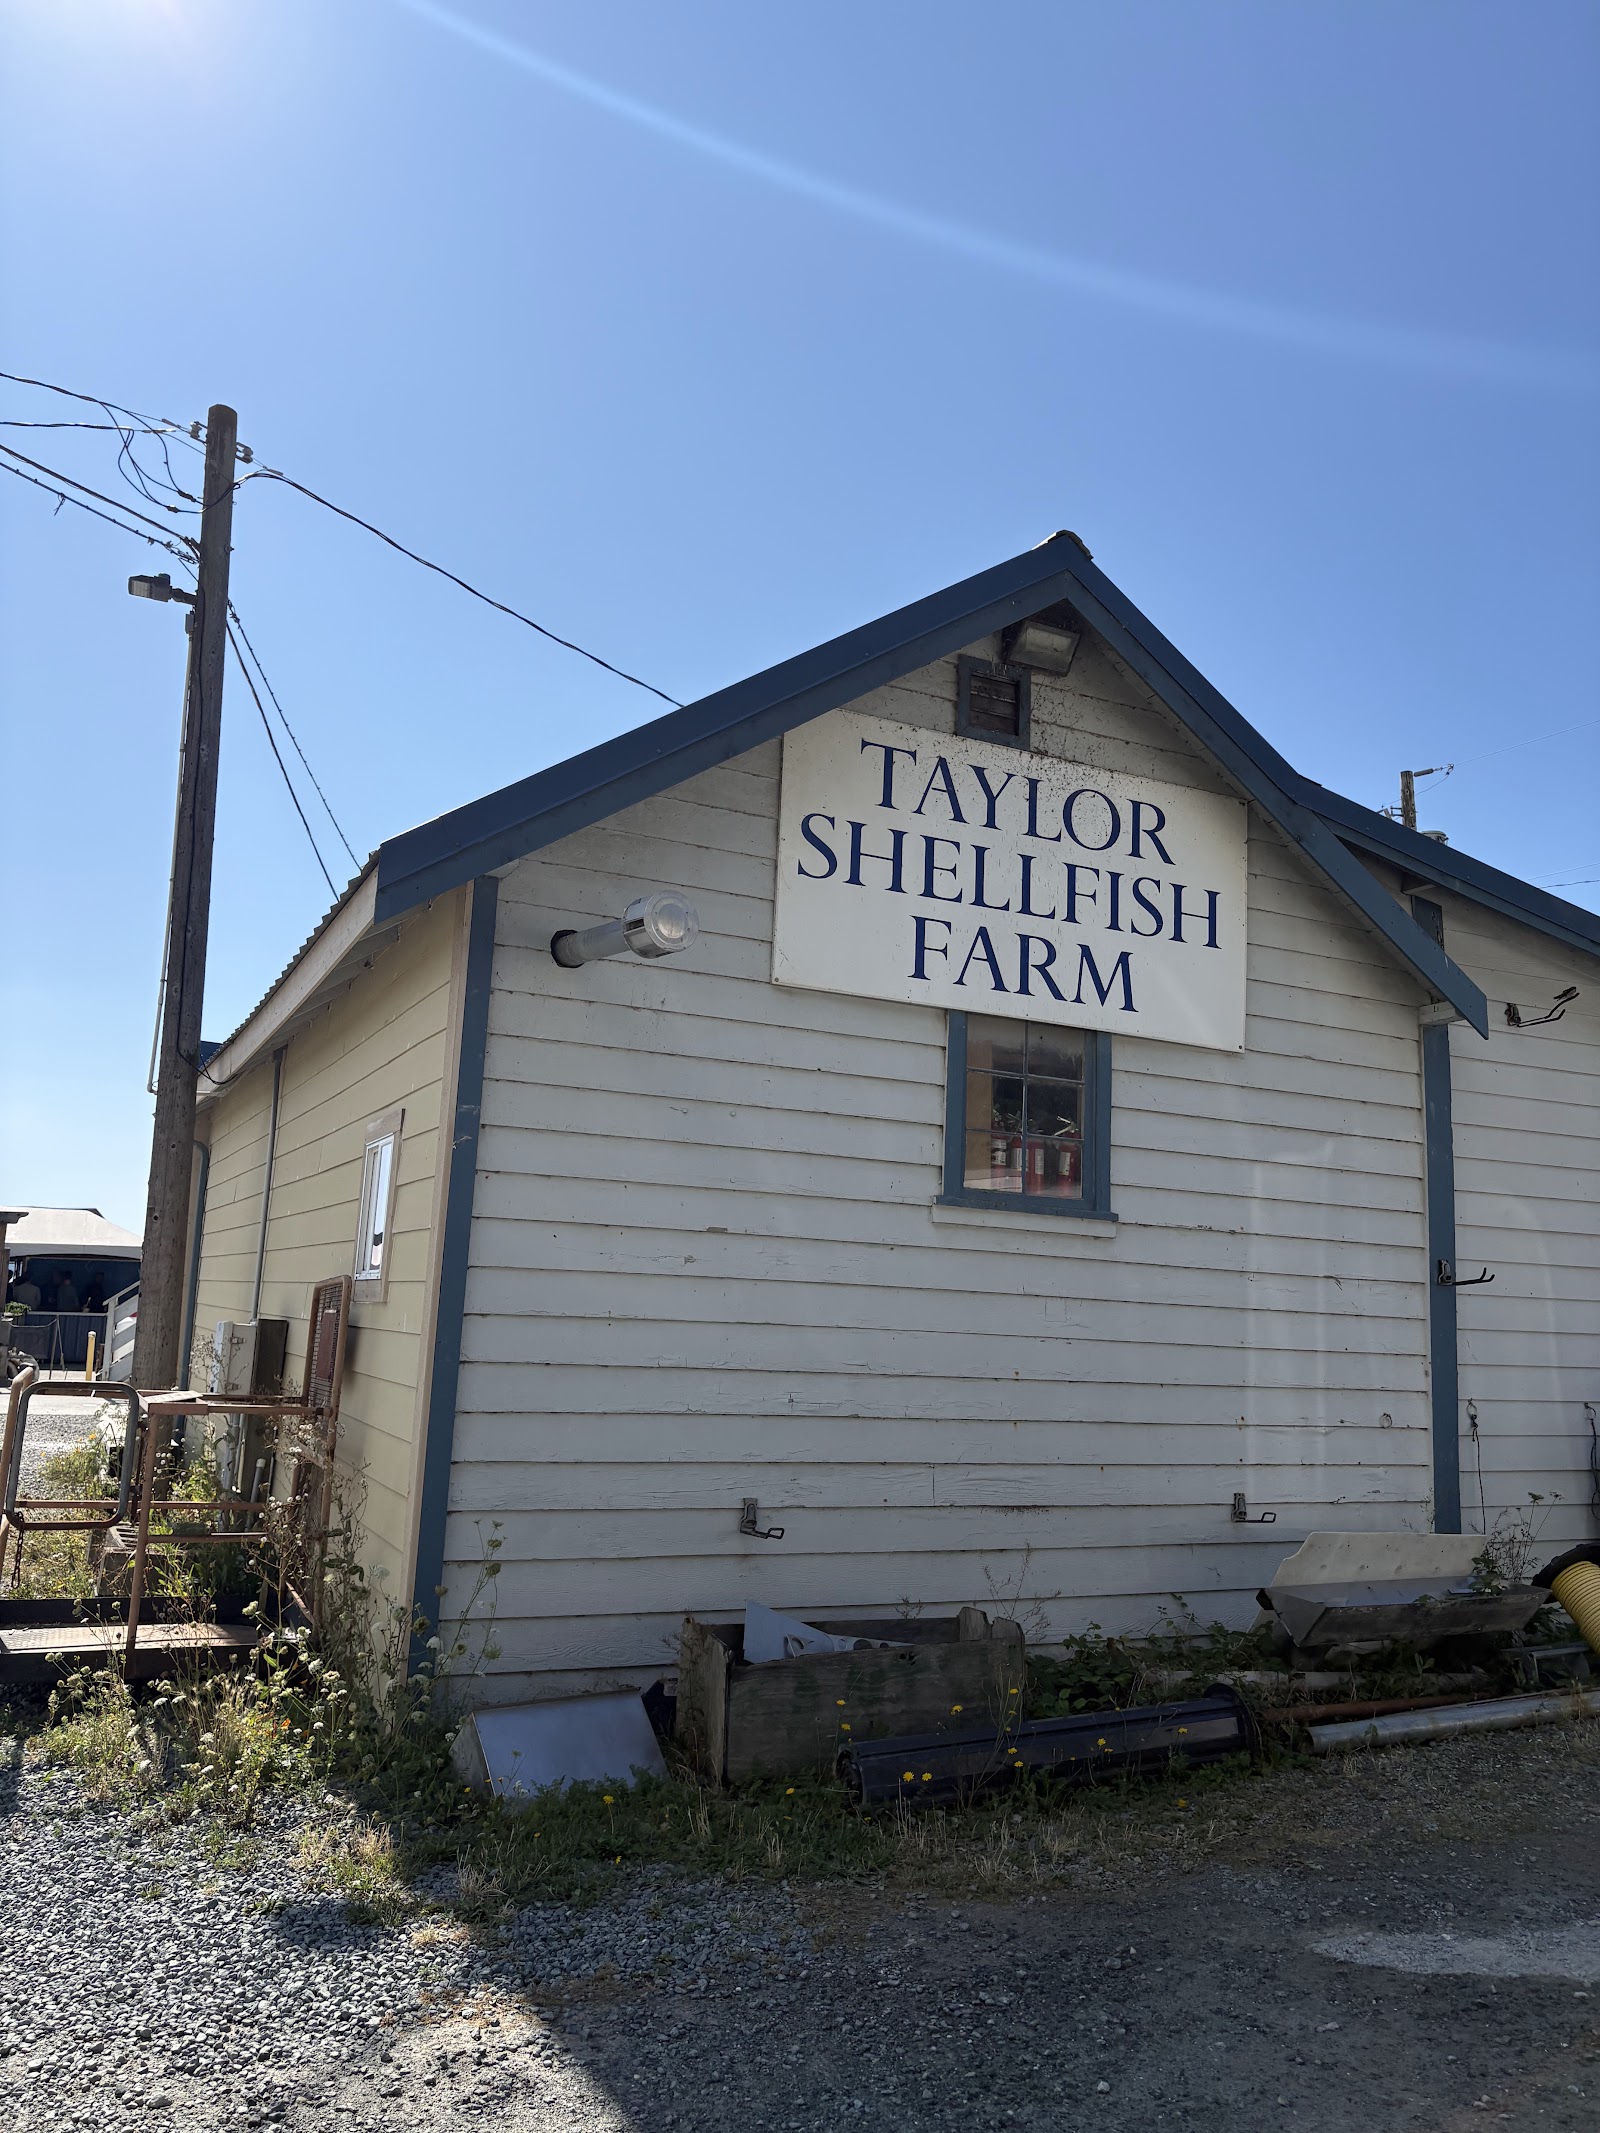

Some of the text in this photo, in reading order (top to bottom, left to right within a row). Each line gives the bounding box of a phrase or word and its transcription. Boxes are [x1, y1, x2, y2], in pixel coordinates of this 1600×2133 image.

[861, 738, 1176, 865] TAYLOR
[797, 813, 1222, 949] SHELLFISH
[908, 915, 1139, 1013] FARM
